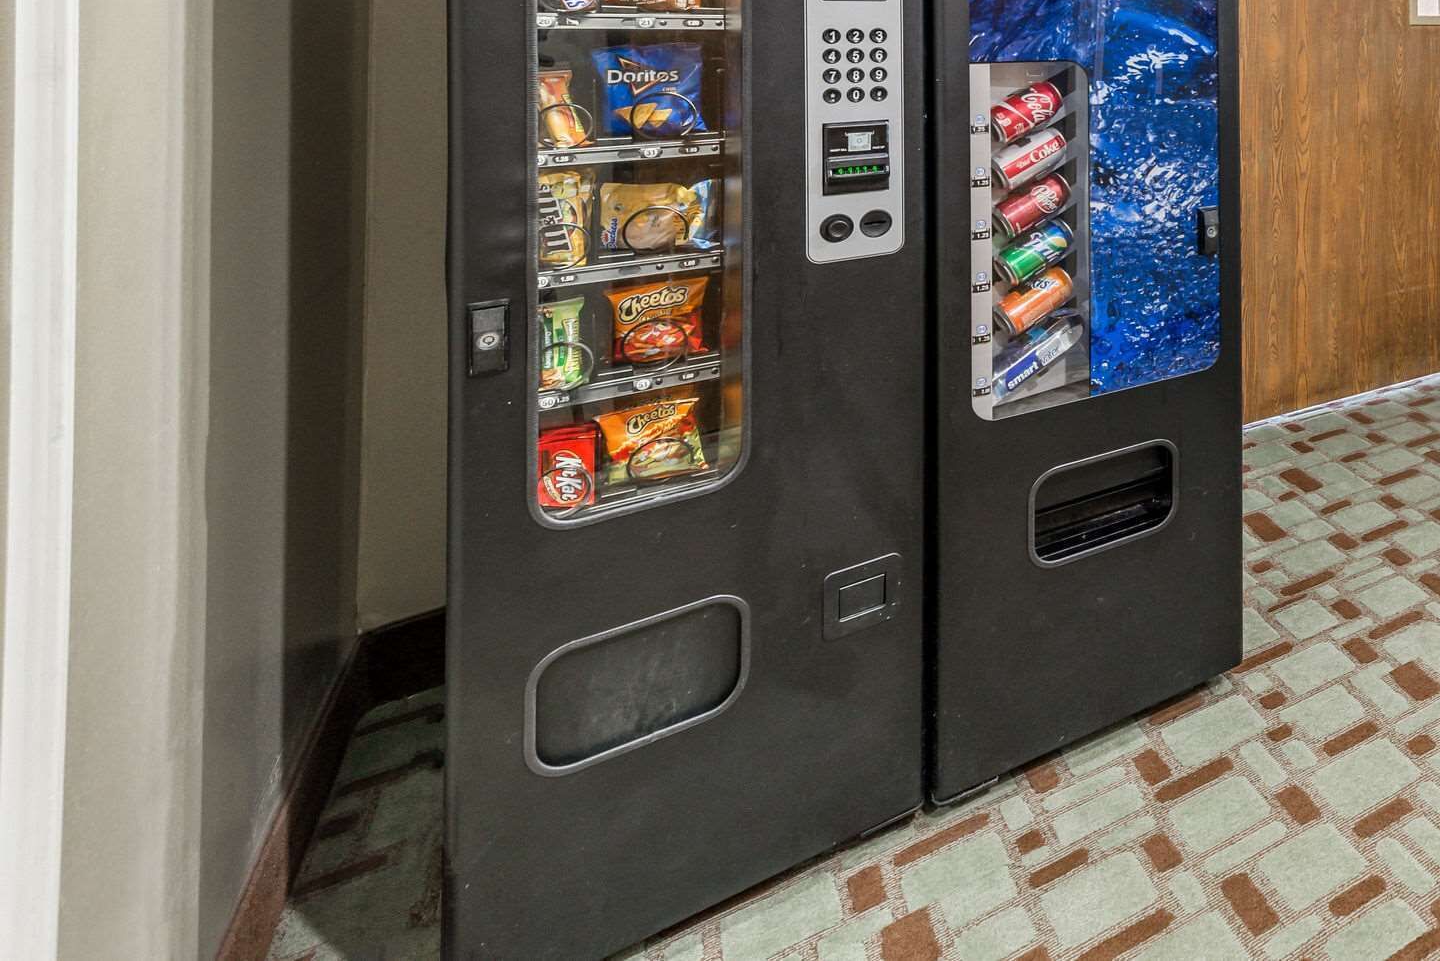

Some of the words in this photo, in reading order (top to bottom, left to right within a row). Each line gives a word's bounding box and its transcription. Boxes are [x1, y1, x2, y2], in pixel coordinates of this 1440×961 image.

[829, 31, 836, 42] 1
[852, 31, 860, 41] 2
[875, 30, 883, 41] 3
[828, 51, 836, 62] 4
[852, 50, 860, 60] 5
[875, 50, 883, 61] 6
[607, 69, 679, 85] Doritos
[829, 71, 836, 81] 7
[852, 70, 860, 80] 8
[875, 69, 883, 80] 9
[852, 90, 860, 100] 0
[1029, 140, 1060, 163] Coke
[619, 286, 689, 324] Cheetos
[1007, 362, 1039, 391] smart
[626, 404, 677, 435] Cheetos
